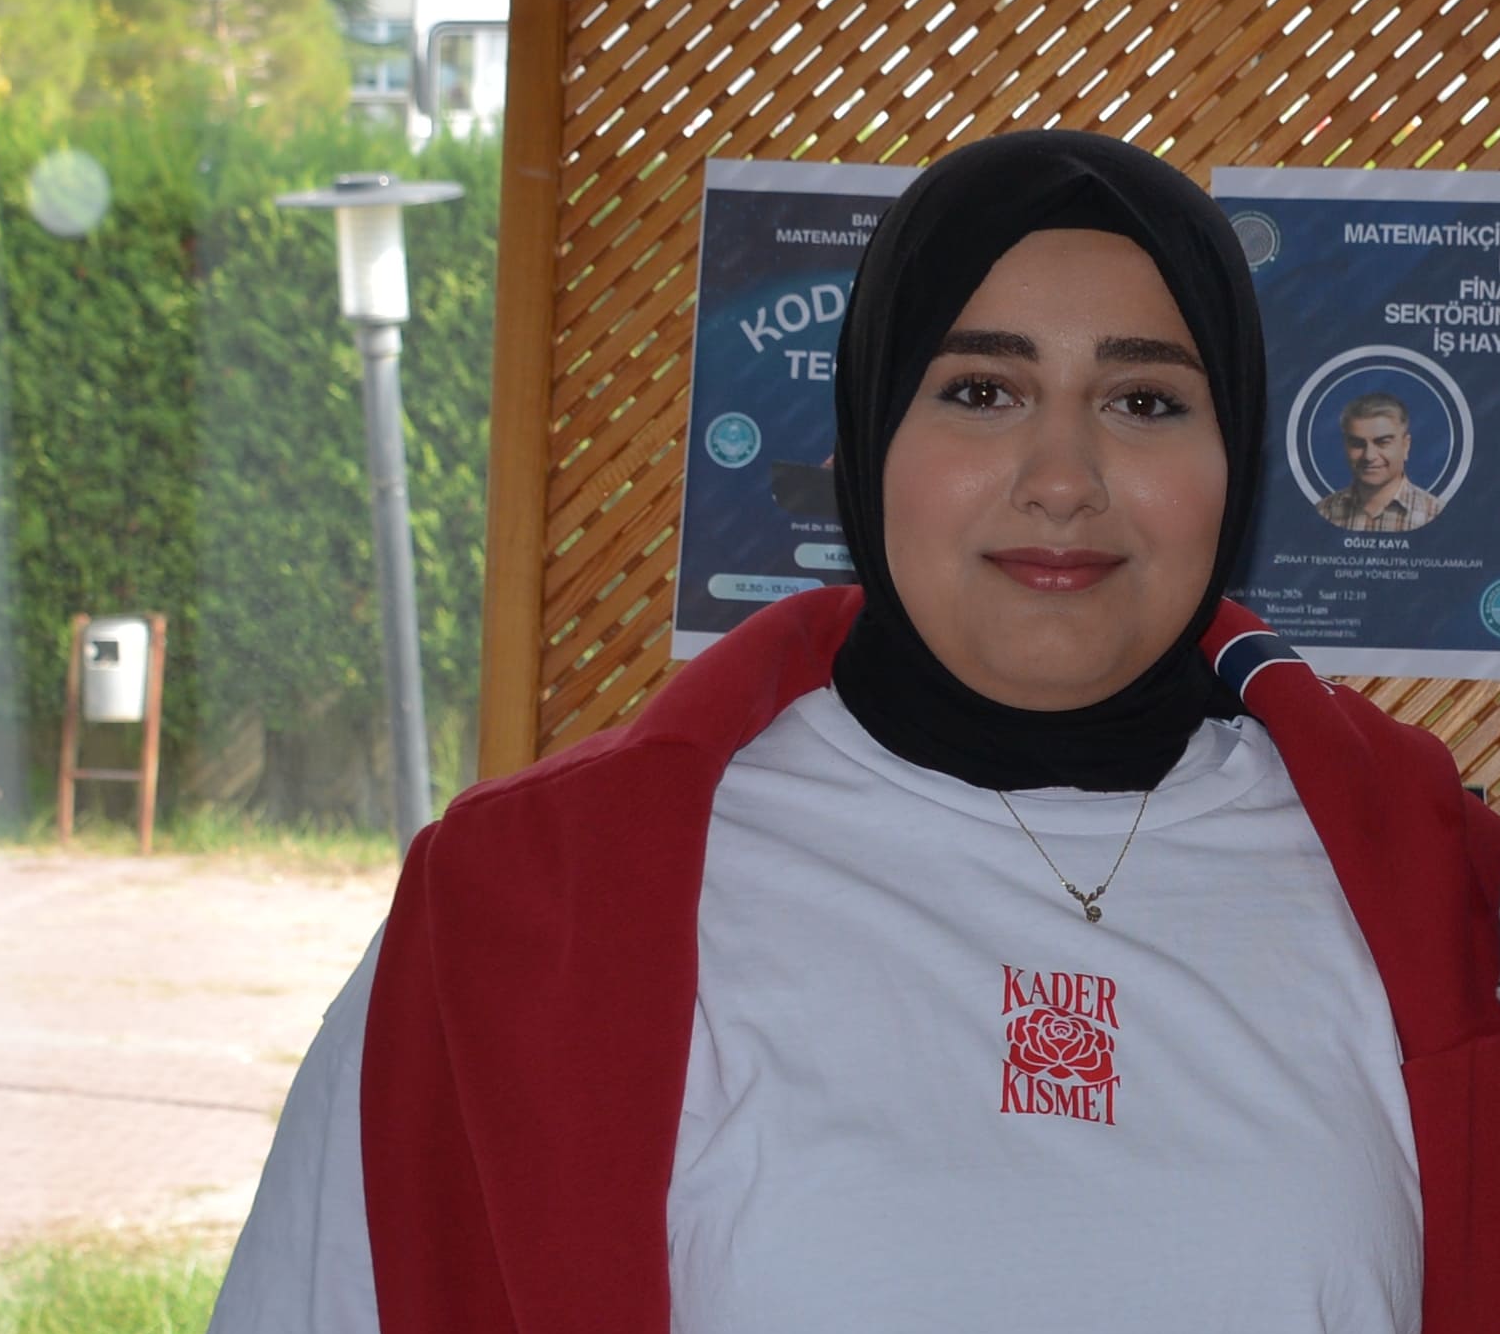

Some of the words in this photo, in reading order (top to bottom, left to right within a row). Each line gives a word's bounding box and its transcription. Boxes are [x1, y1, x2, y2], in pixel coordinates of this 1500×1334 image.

[740, 280, 854, 354] KOD
[1433, 326, 1455, 358] İŞ
[784, 350, 838, 381] TE
[1344, 536, 1377, 550] OĞUZ
[1378, 538, 1411, 551] KAYA
[1334, 569, 1363, 581] GRUP
[1410, 558, 1484, 569] UYGULAMALAR
[1001, 964, 1120, 1030] KADER
[999, 1059, 1121, 1126] KISMET
